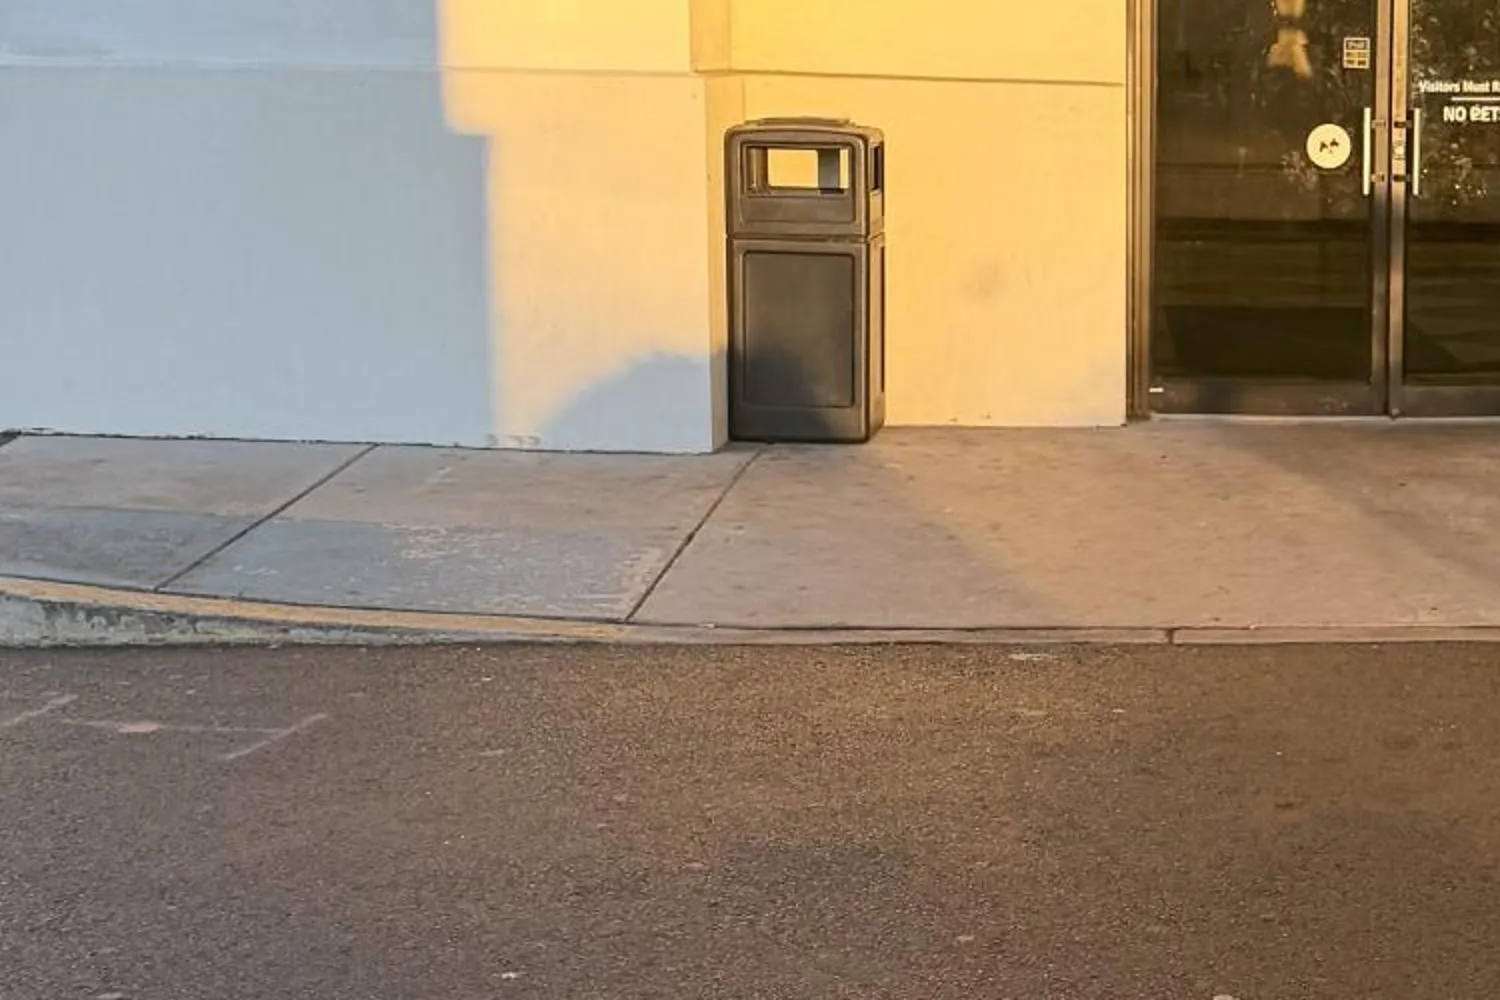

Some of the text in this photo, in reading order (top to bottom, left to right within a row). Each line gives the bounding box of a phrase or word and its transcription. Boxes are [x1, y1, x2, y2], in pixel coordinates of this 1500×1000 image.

[1418, 79, 1461, 93] Visitors
[1463, 79, 1491, 93] Must
[1443, 105, 1467, 123] NO
